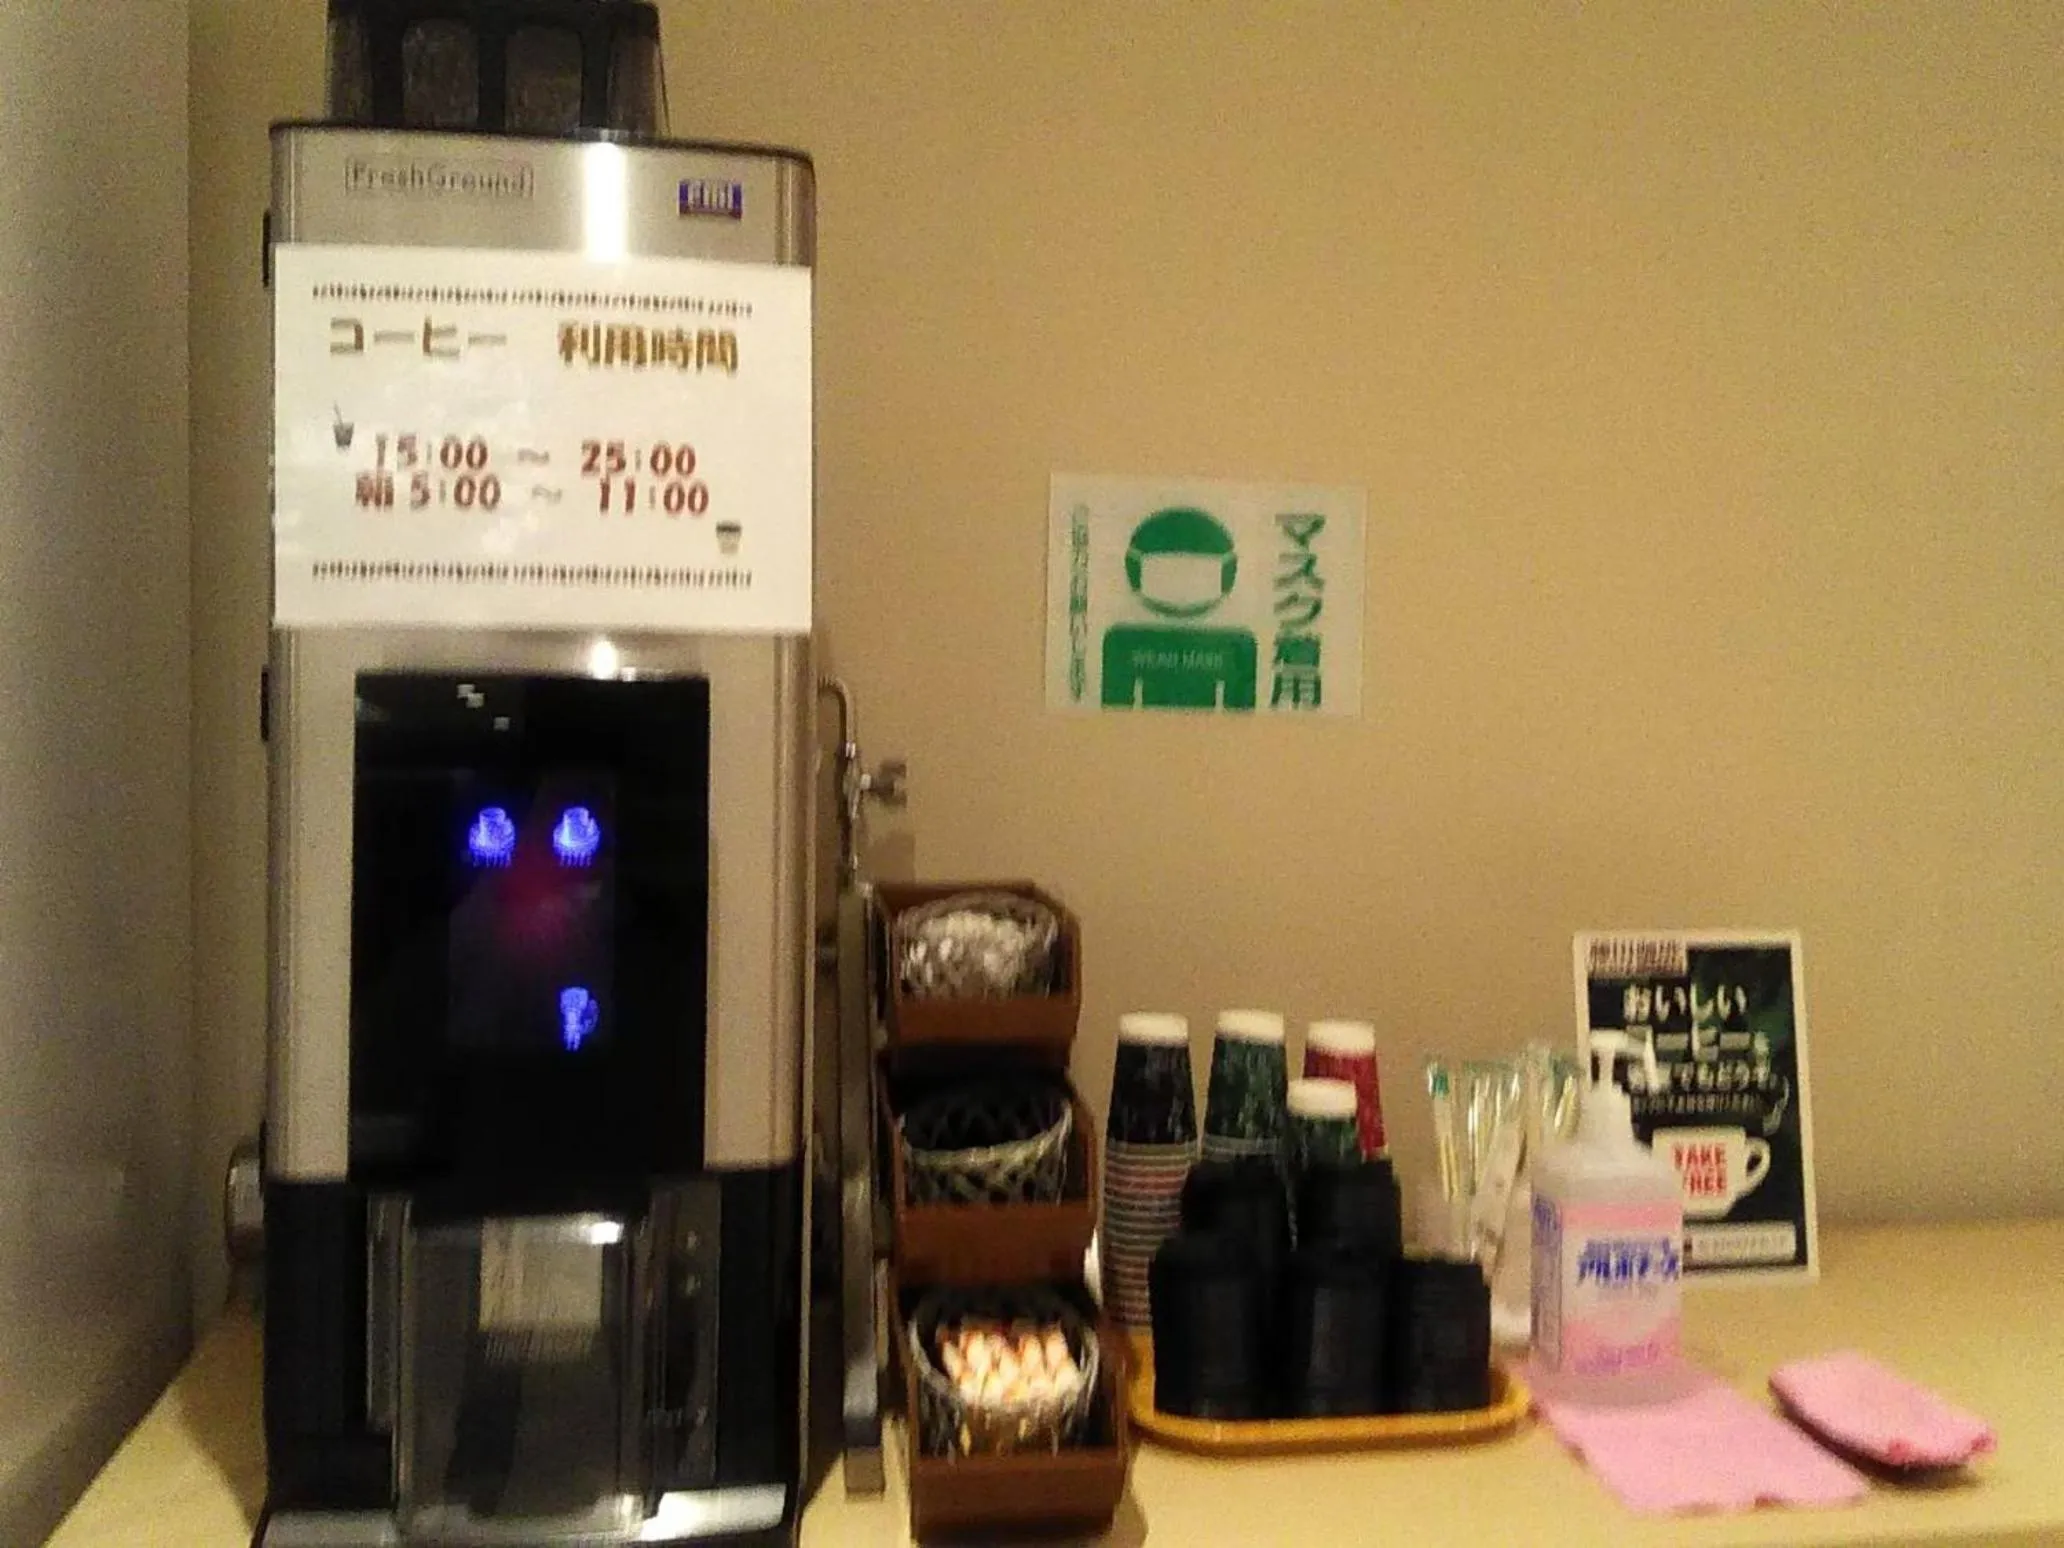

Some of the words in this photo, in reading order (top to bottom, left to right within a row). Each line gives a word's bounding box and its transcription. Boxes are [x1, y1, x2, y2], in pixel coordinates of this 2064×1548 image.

[330, 316, 507, 359] コーヒー
[376, 433, 488, 470] 15:00
[582, 439, 696, 477] 25:00
[411, 470, 501, 511] 5:00
[599, 475, 709, 518] 11:00
[1624, 984, 1747, 1023] おいしい
